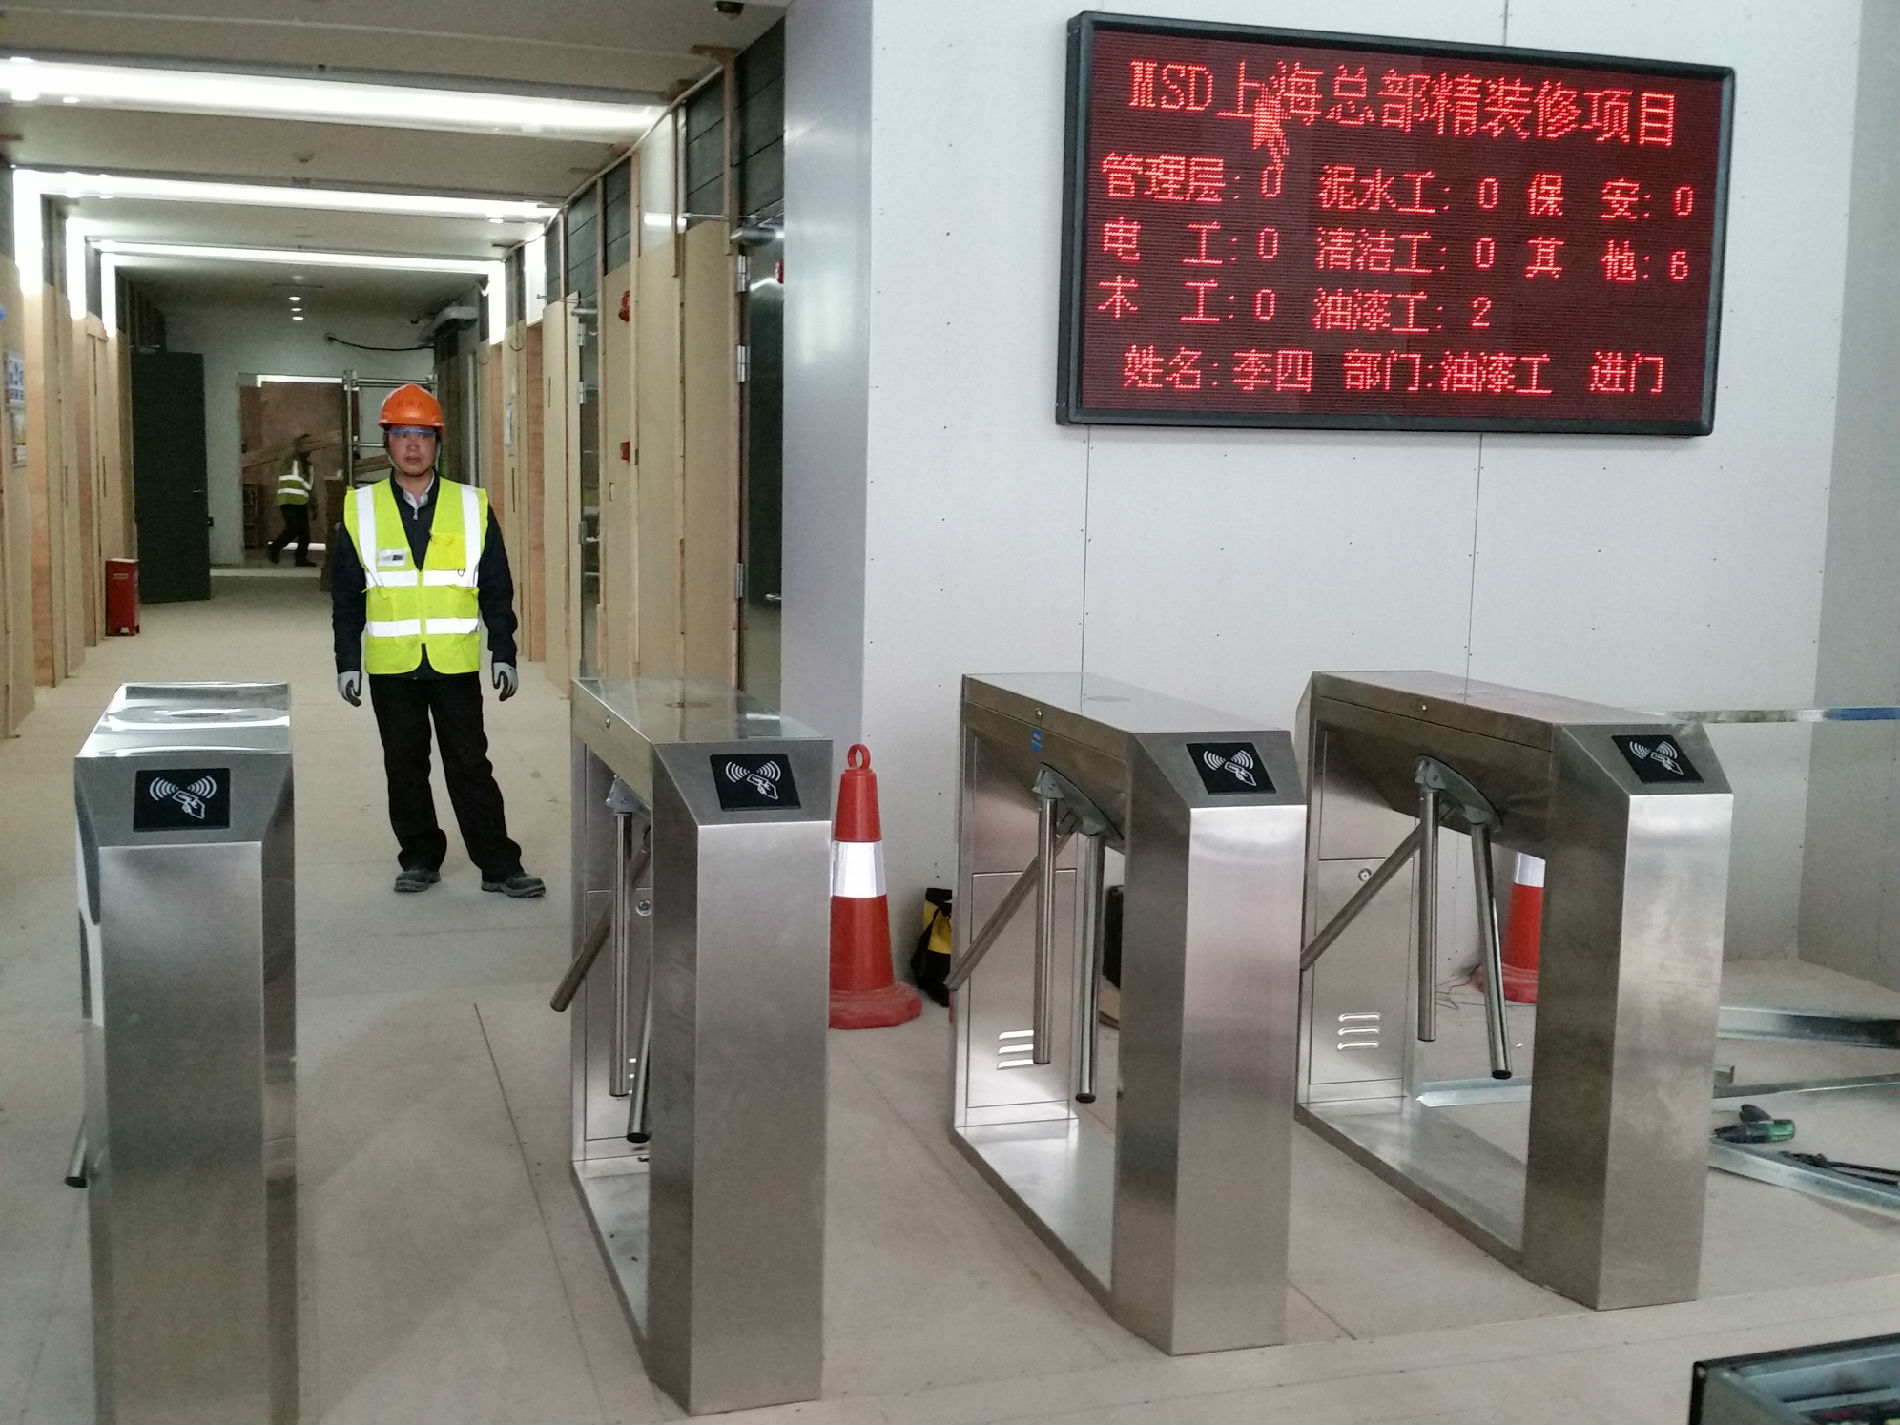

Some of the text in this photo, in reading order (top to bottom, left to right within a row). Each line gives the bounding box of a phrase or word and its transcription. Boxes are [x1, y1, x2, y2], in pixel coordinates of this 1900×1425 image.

[1260, 165, 1282, 197] 0
[1478, 177, 1499, 209] 0
[1527, 173, 1564, 217] 保
[1674, 186, 1694, 216] 0
[1103, 216, 1142, 263] 电
[1257, 227, 1279, 259] 0
[1475, 237, 1495, 269] 0
[1525, 236, 1565, 279] 其
[1669, 250, 1689, 280] 6
[1097, 275, 1139, 319] 木
[1254, 288, 1276, 321] 0
[1471, 296, 1492, 327] 2
[1232, 348, 1313, 393] 李四
[1589, 351, 1664, 393] 进门
